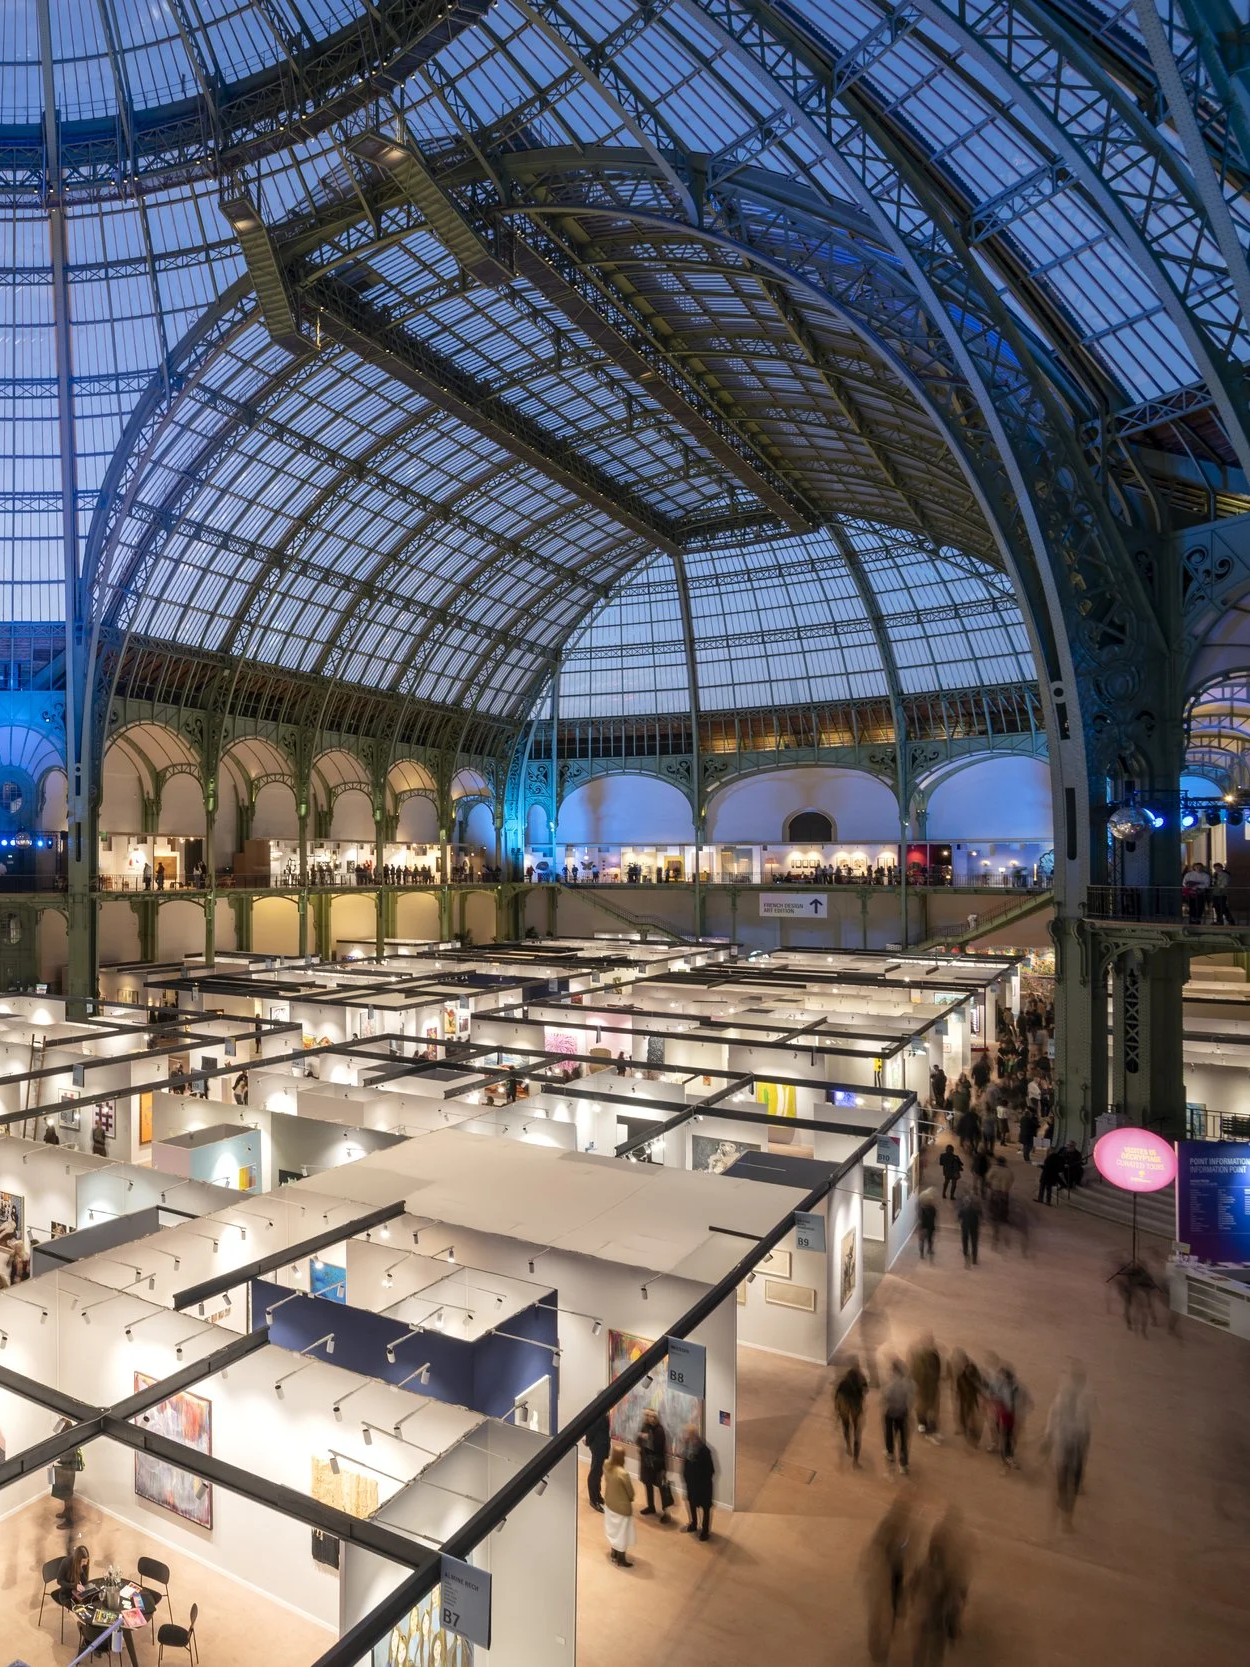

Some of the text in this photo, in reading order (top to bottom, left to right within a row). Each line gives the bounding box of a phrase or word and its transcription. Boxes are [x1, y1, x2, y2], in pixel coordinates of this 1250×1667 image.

[1190, 1157, 1250, 1165] POINT INFORMATION
[1190, 1165, 1246, 1173] INFORMATION POINT
[798, 1237, 809, 1247] B9
[670, 1370, 684, 1383] B8
[444, 1571, 479, 1592] ALMINE RECH
[443, 1607, 460, 1627] B7
